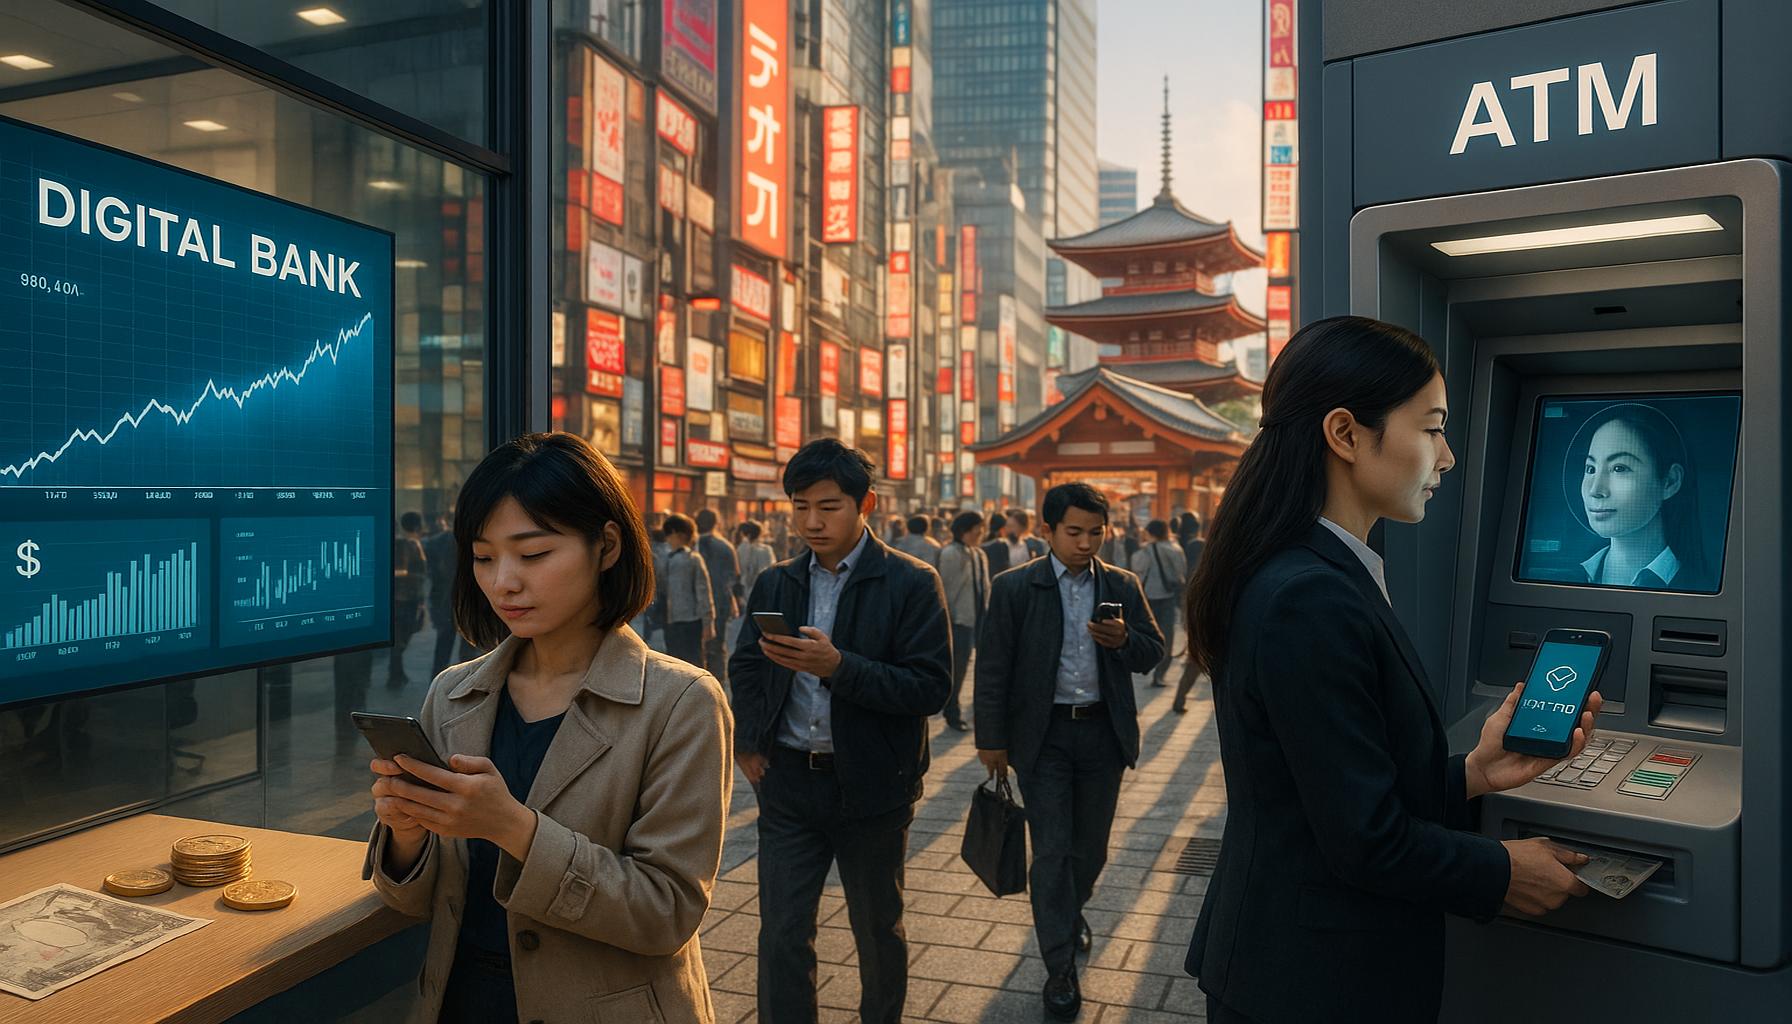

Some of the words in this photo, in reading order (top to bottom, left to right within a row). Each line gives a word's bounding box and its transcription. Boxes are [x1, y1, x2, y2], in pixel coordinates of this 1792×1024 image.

[1449, 52, 1657, 155] ATM
[39, 177, 236, 269] DIGITAL
[251, 233, 362, 299] BANK
